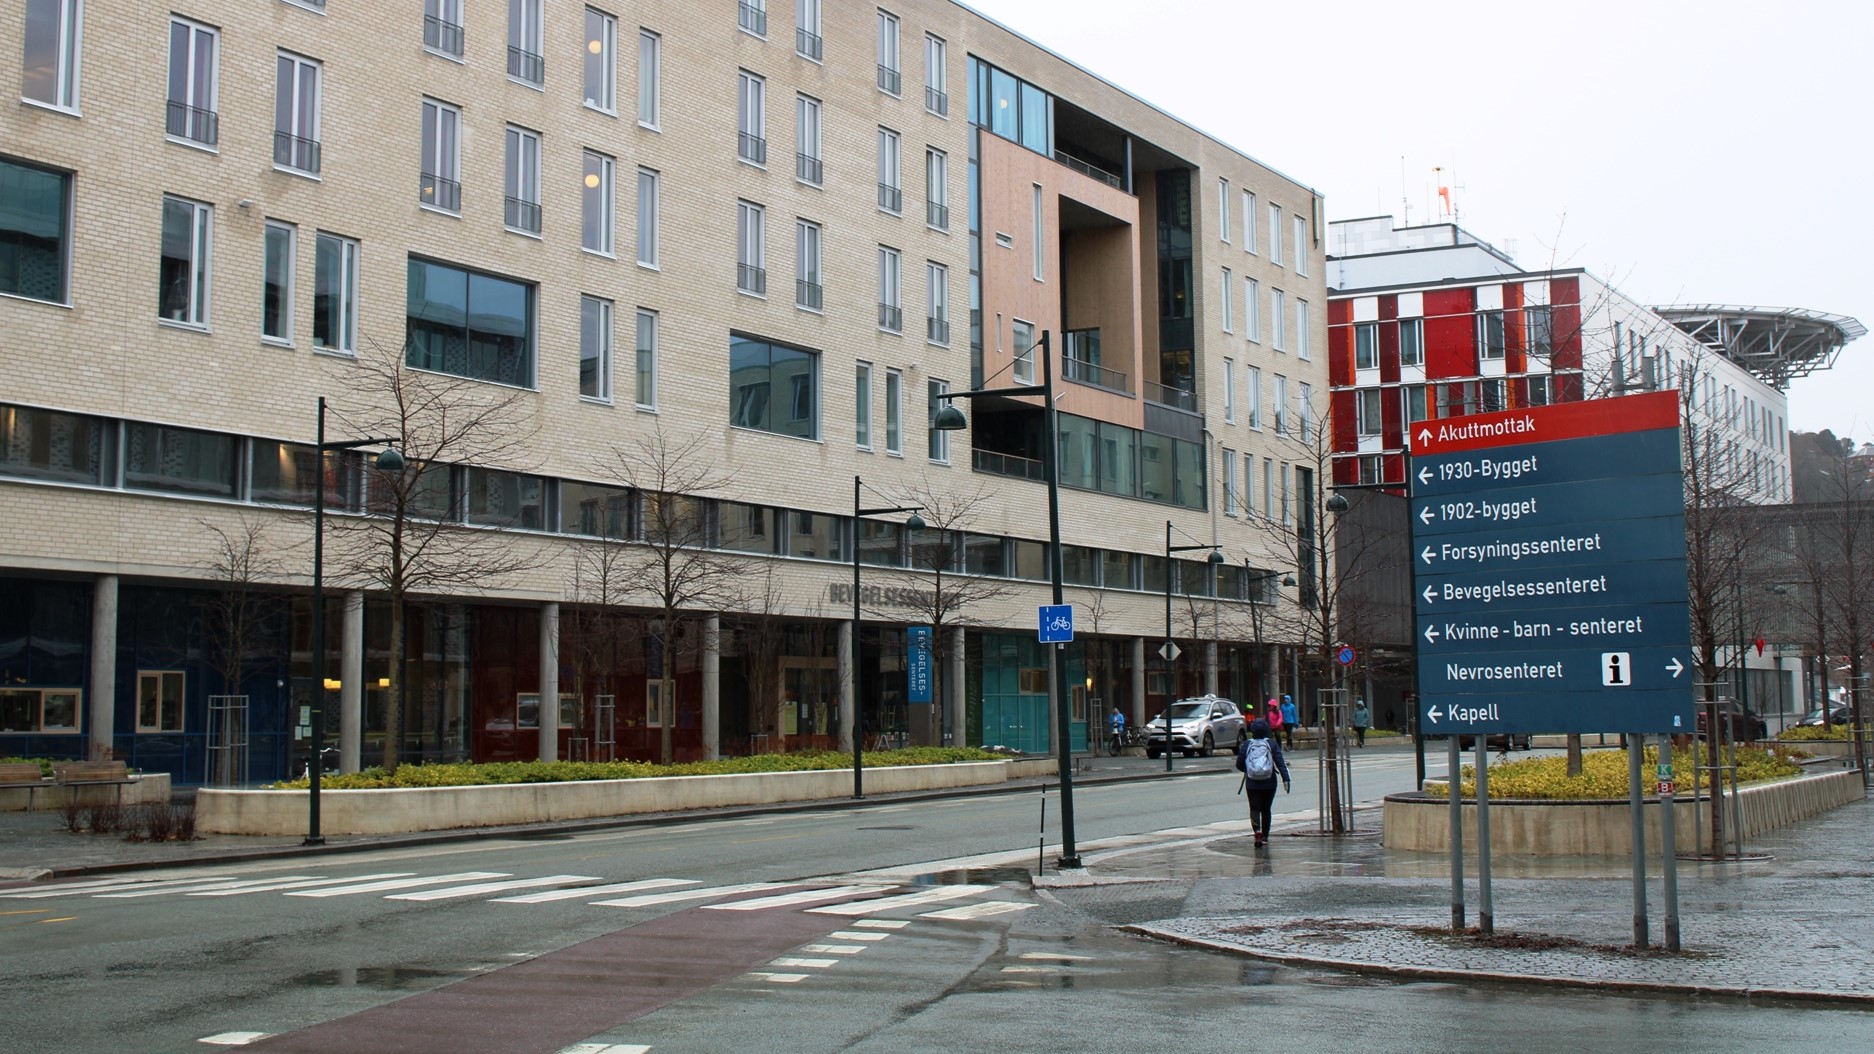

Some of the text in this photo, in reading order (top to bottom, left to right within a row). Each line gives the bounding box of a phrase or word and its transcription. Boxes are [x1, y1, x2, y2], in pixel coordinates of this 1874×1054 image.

[1438, 415, 1536, 442] Akuttmottak
[1439, 455, 1538, 481] 1930-Bygget
[1440, 497, 1537, 521] 1902-bygget
[1442, 533, 1601, 562] Forsyningssenteret
[1444, 575, 1607, 602] Bevegelsessenteret
[1445, 623, 1499, 640] Kvinne
[1513, 620, 1551, 638] barn
[1570, 616, 1643, 636] senteret
[1447, 661, 1563, 681] Nevrosenteret
[1448, 703, 1500, 725] Kapell
[1660, 764, 1669, 775] K
[1661, 783, 1669, 792] B
